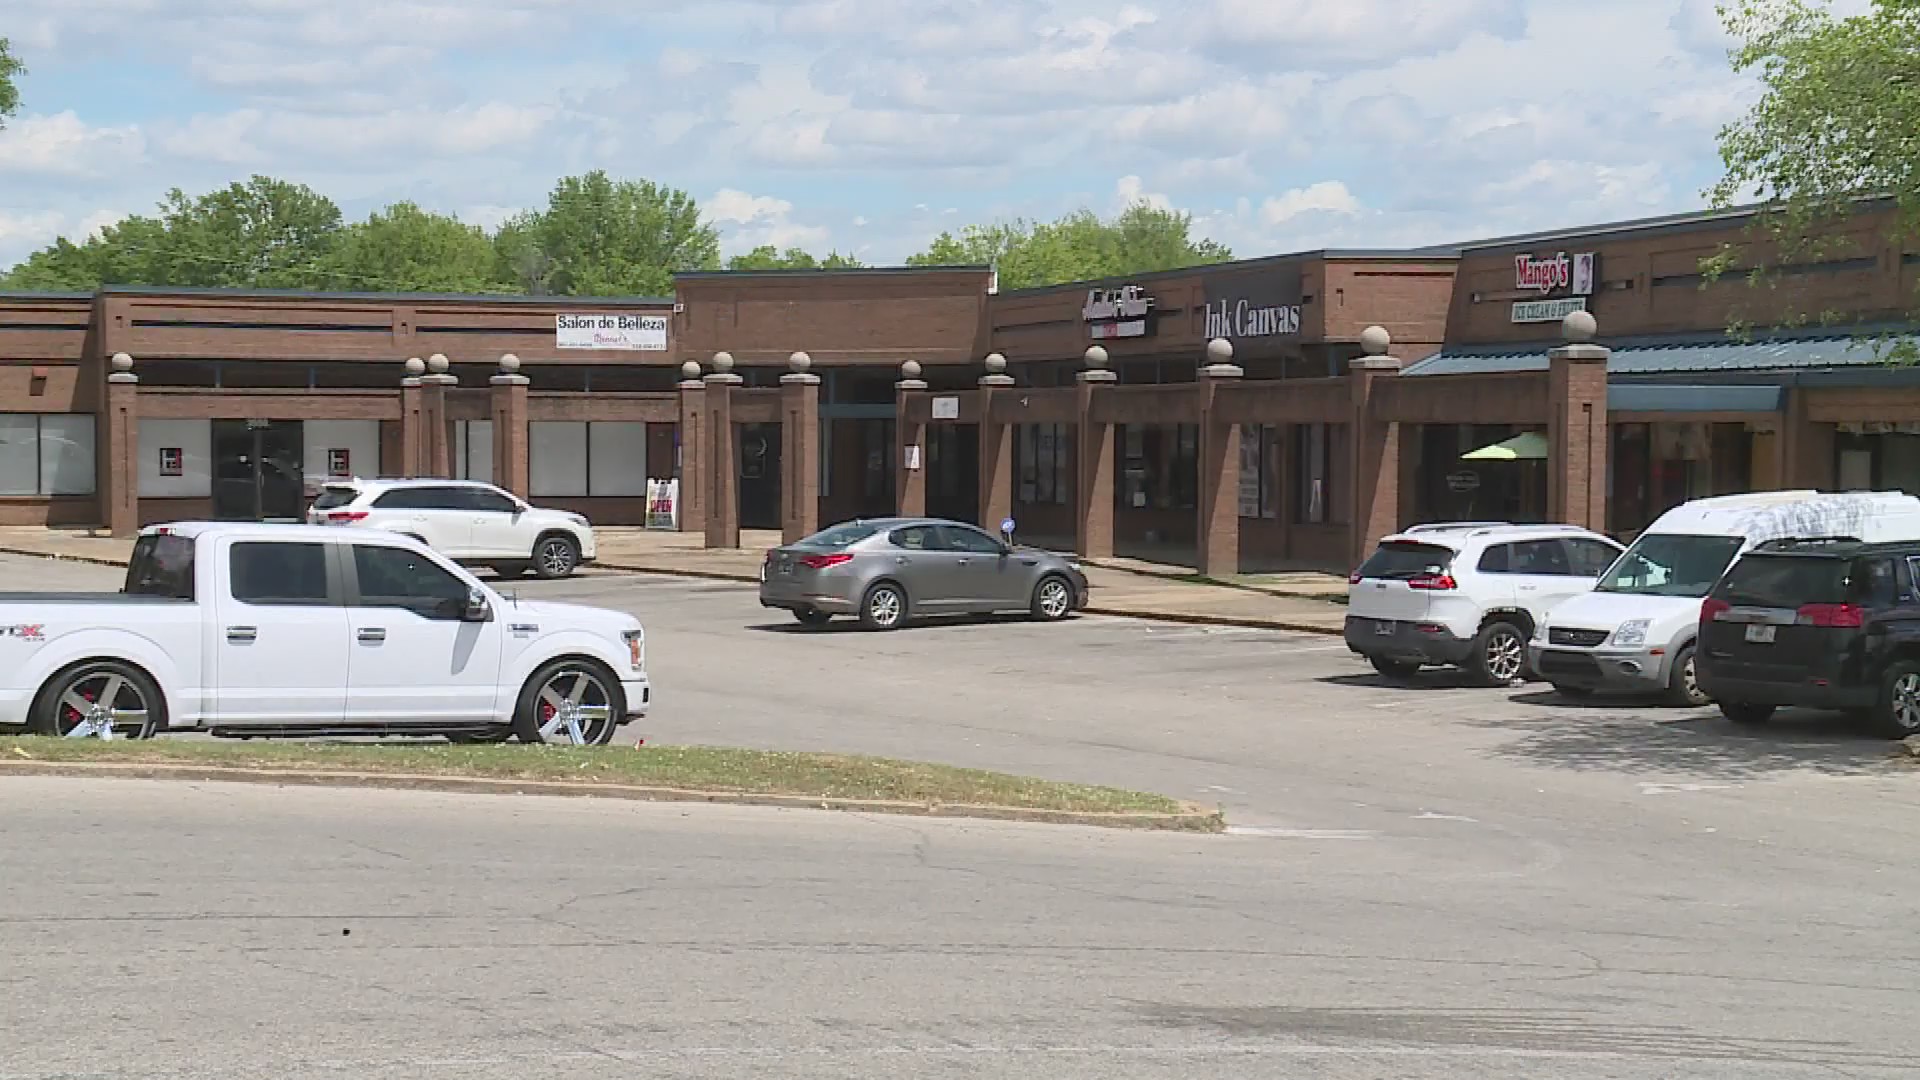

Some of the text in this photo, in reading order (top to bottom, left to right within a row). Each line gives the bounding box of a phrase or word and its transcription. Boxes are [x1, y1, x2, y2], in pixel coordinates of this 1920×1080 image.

[1516, 253, 1568, 293] Mango's
[558, 315, 665, 331] Salon de Belleza
[1204, 299, 1300, 339] Ink Canvas
[651, 499, 672, 512] OPEN
